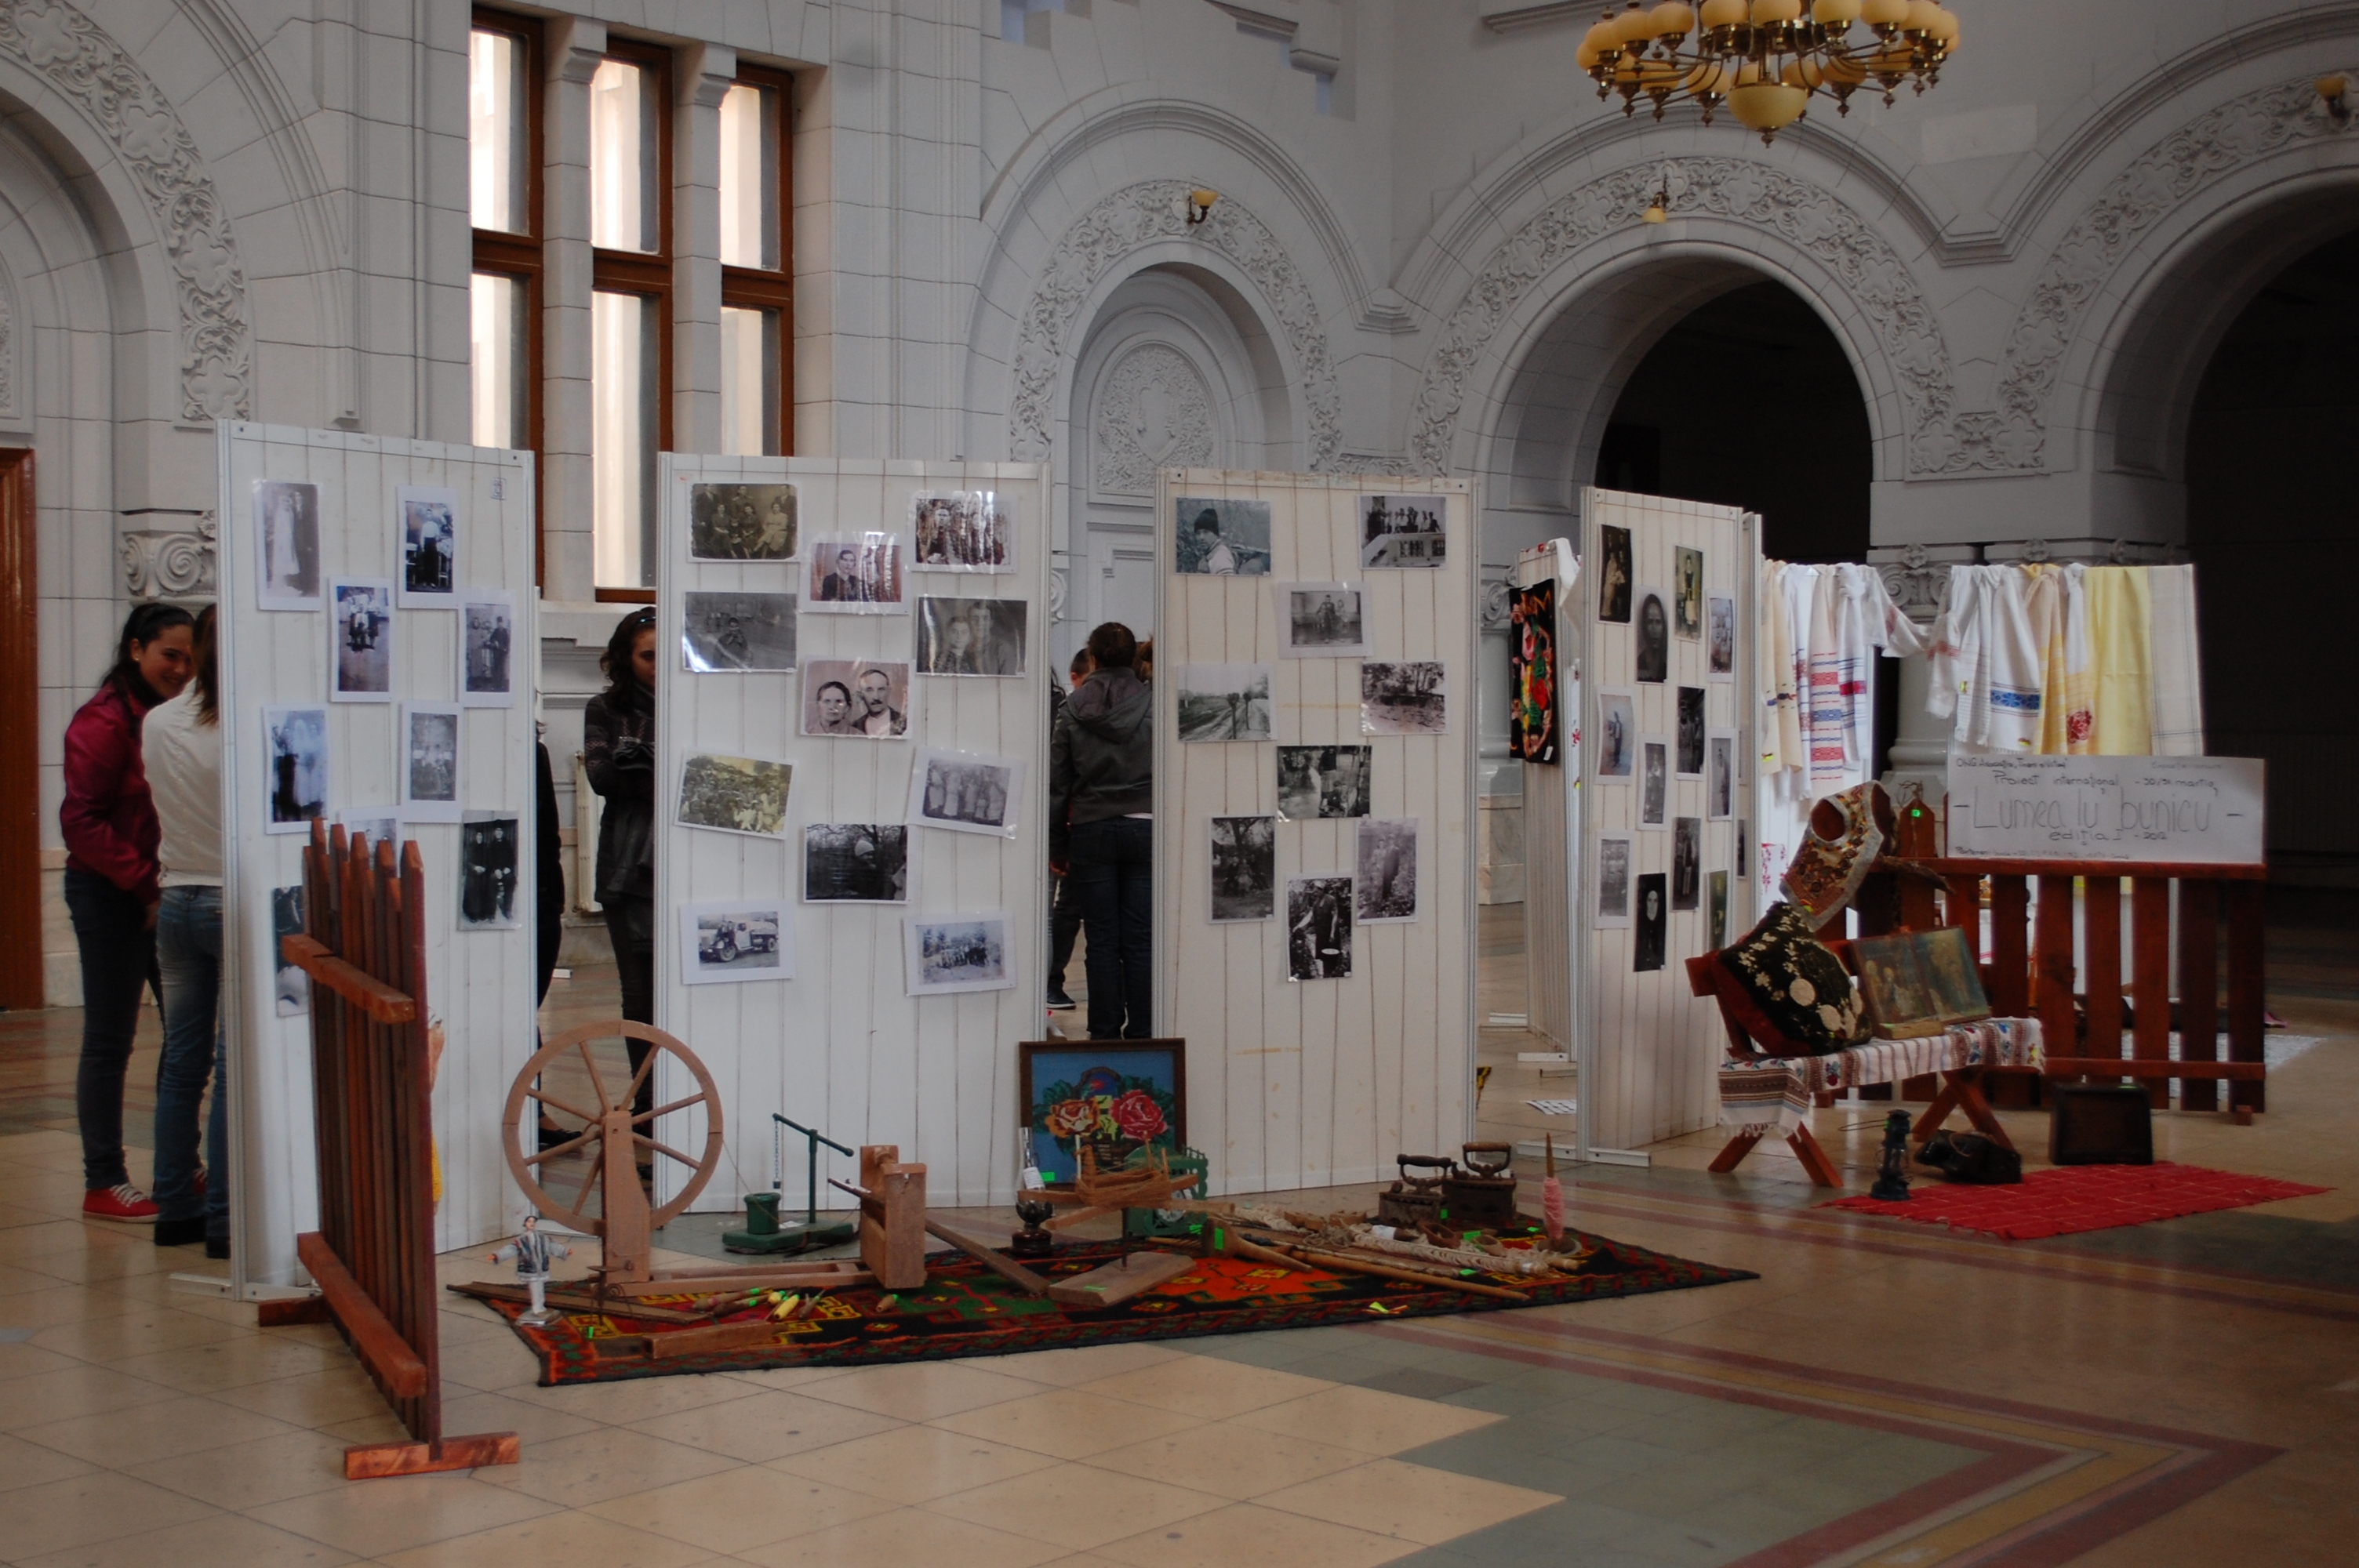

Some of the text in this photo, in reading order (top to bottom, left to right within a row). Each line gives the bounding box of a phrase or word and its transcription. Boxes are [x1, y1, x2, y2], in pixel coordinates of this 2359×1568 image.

[1992, 769, 2040, 785] Proiect
[1974, 786, 2066, 831] Lumea
[2077, 787, 2098, 829] lu
[2120, 786, 2211, 833] bunicu
